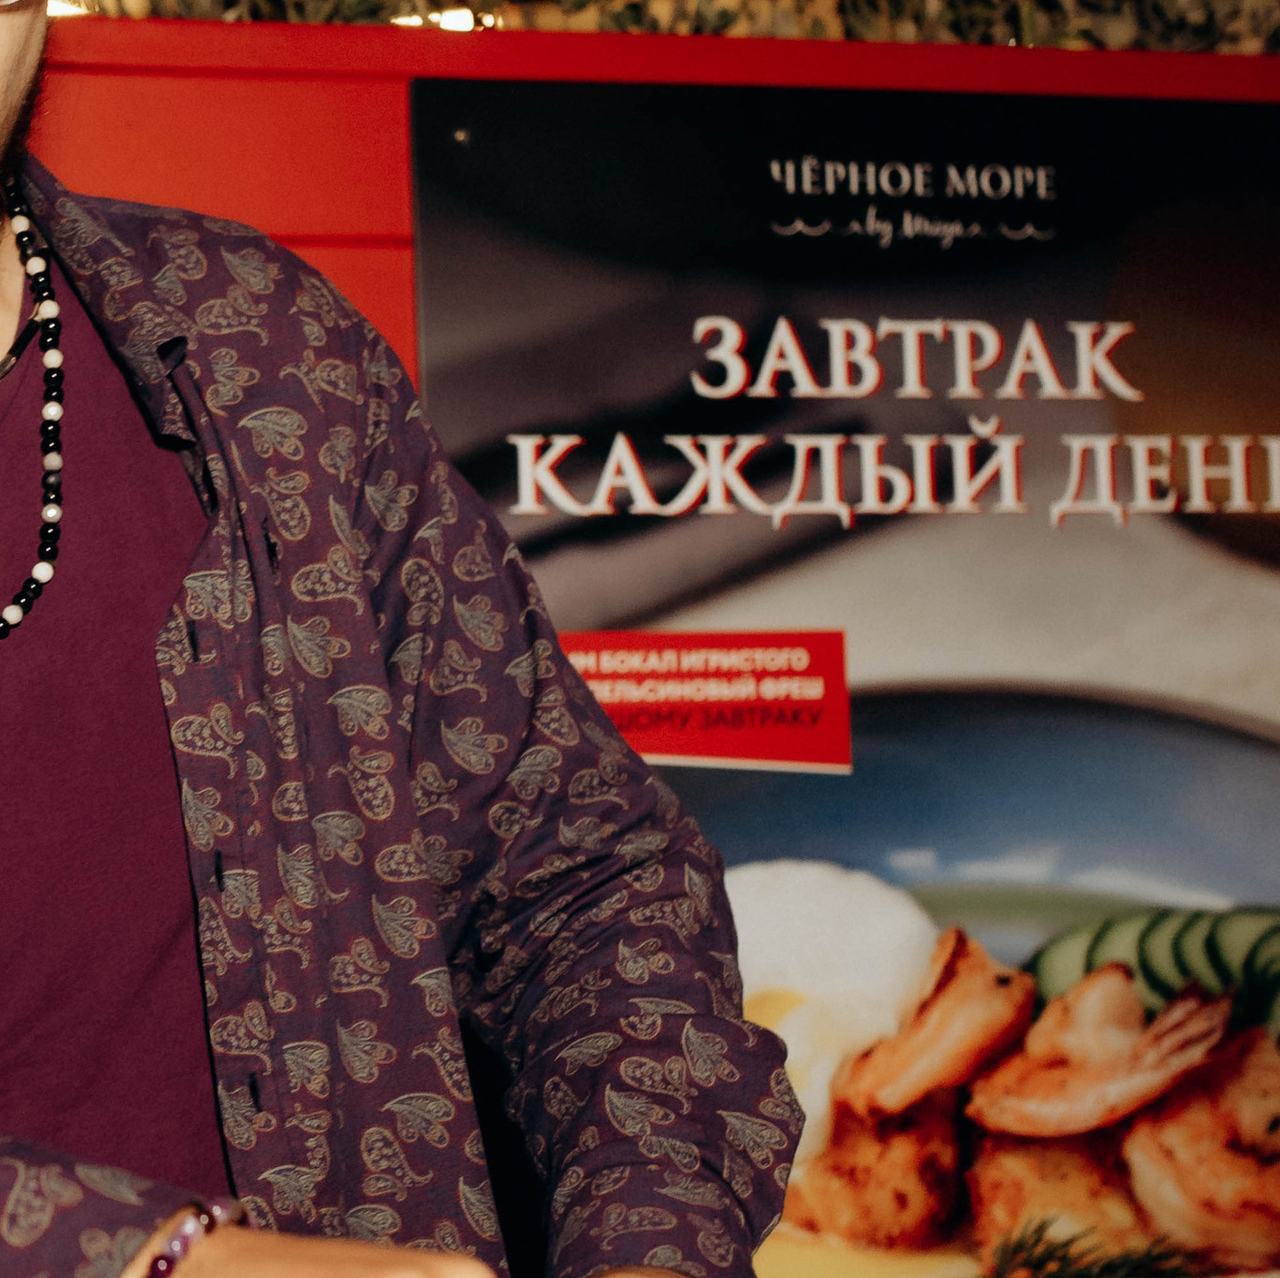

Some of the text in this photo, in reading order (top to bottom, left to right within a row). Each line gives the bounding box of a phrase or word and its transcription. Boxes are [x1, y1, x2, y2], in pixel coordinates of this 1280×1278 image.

[769, 154, 1056, 200] ЧЁРНОЕ МОРЕ
[690, 316, 1144, 402] ЗАВТРАК
[508, 414, 1027, 530] КАЖДЫЙ
